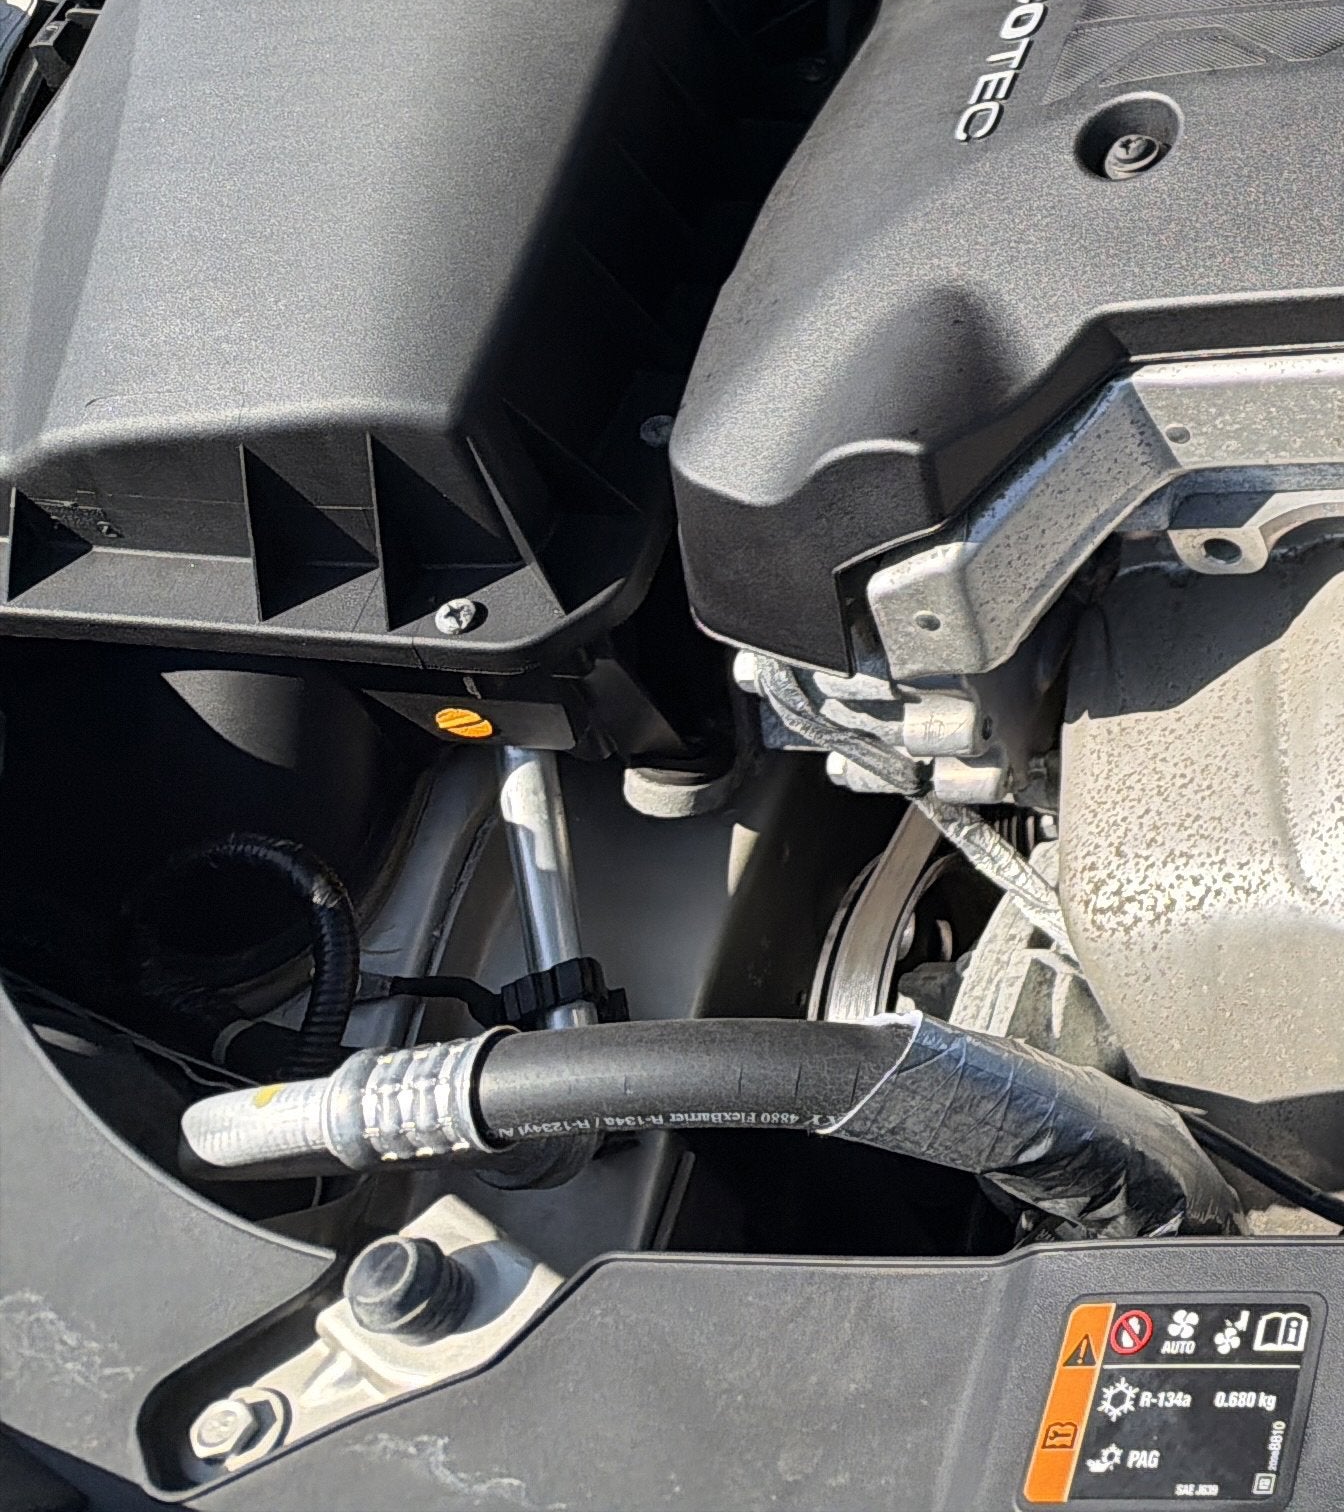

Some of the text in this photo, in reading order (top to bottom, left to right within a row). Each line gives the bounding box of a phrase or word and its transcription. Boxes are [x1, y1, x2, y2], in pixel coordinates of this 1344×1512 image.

[761, 1112, 800, 1124] 4880
[1160, 1341, 1196, 1355] AUTO
[1139, 1391, 1277, 1411] R-134a 0.680 kg
[1127, 1450, 1161, 1469] PAG
[1174, 1484, 1195, 1496] SAE
